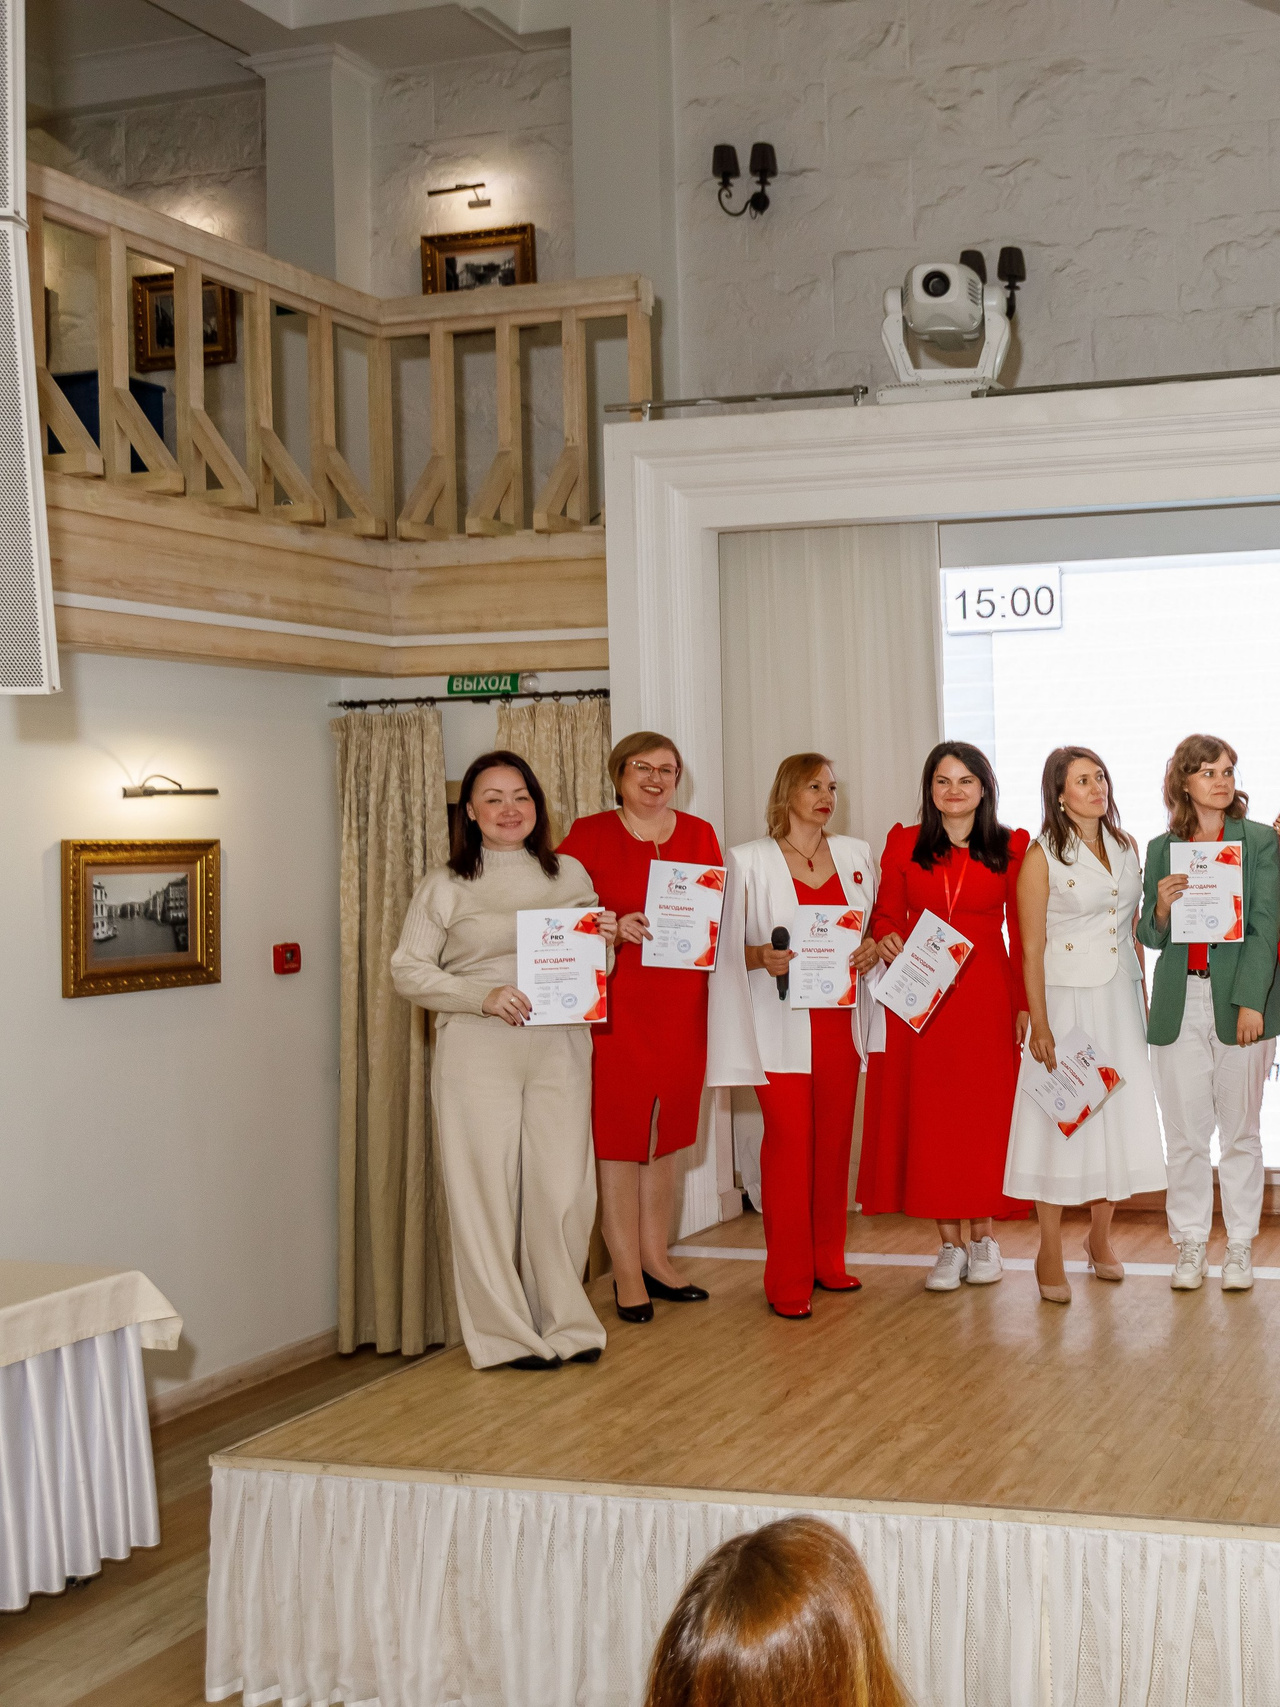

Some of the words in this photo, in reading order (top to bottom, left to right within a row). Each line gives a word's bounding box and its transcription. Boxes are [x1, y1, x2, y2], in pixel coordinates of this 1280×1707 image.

[955, 585, 1055, 620] 15:00
[452, 676, 512, 691] ВЫХОД
[658, 904, 695, 912] БЛАГОДАРИМ
